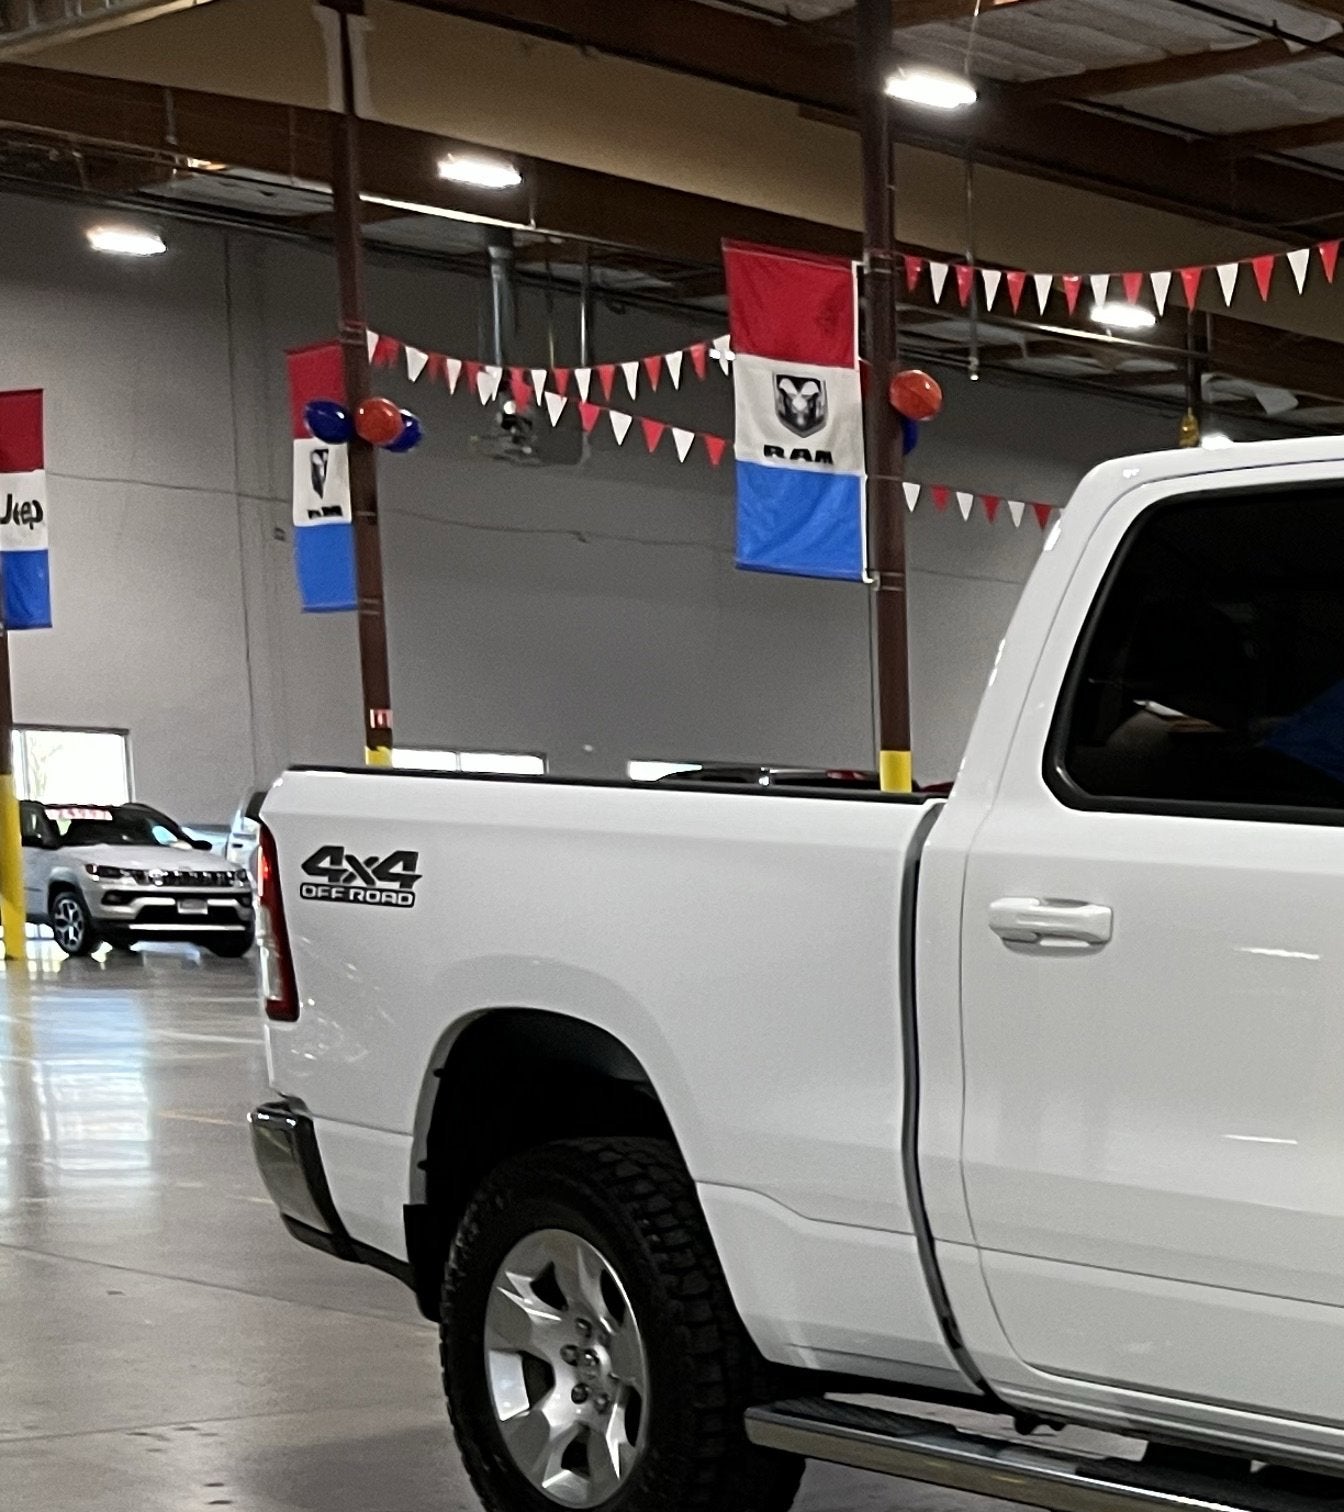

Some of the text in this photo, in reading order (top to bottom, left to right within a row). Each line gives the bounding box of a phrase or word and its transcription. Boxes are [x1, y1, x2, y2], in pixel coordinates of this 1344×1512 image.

[763, 444, 834, 465] RAM
[302, 885, 414, 906] OFF ROAD
